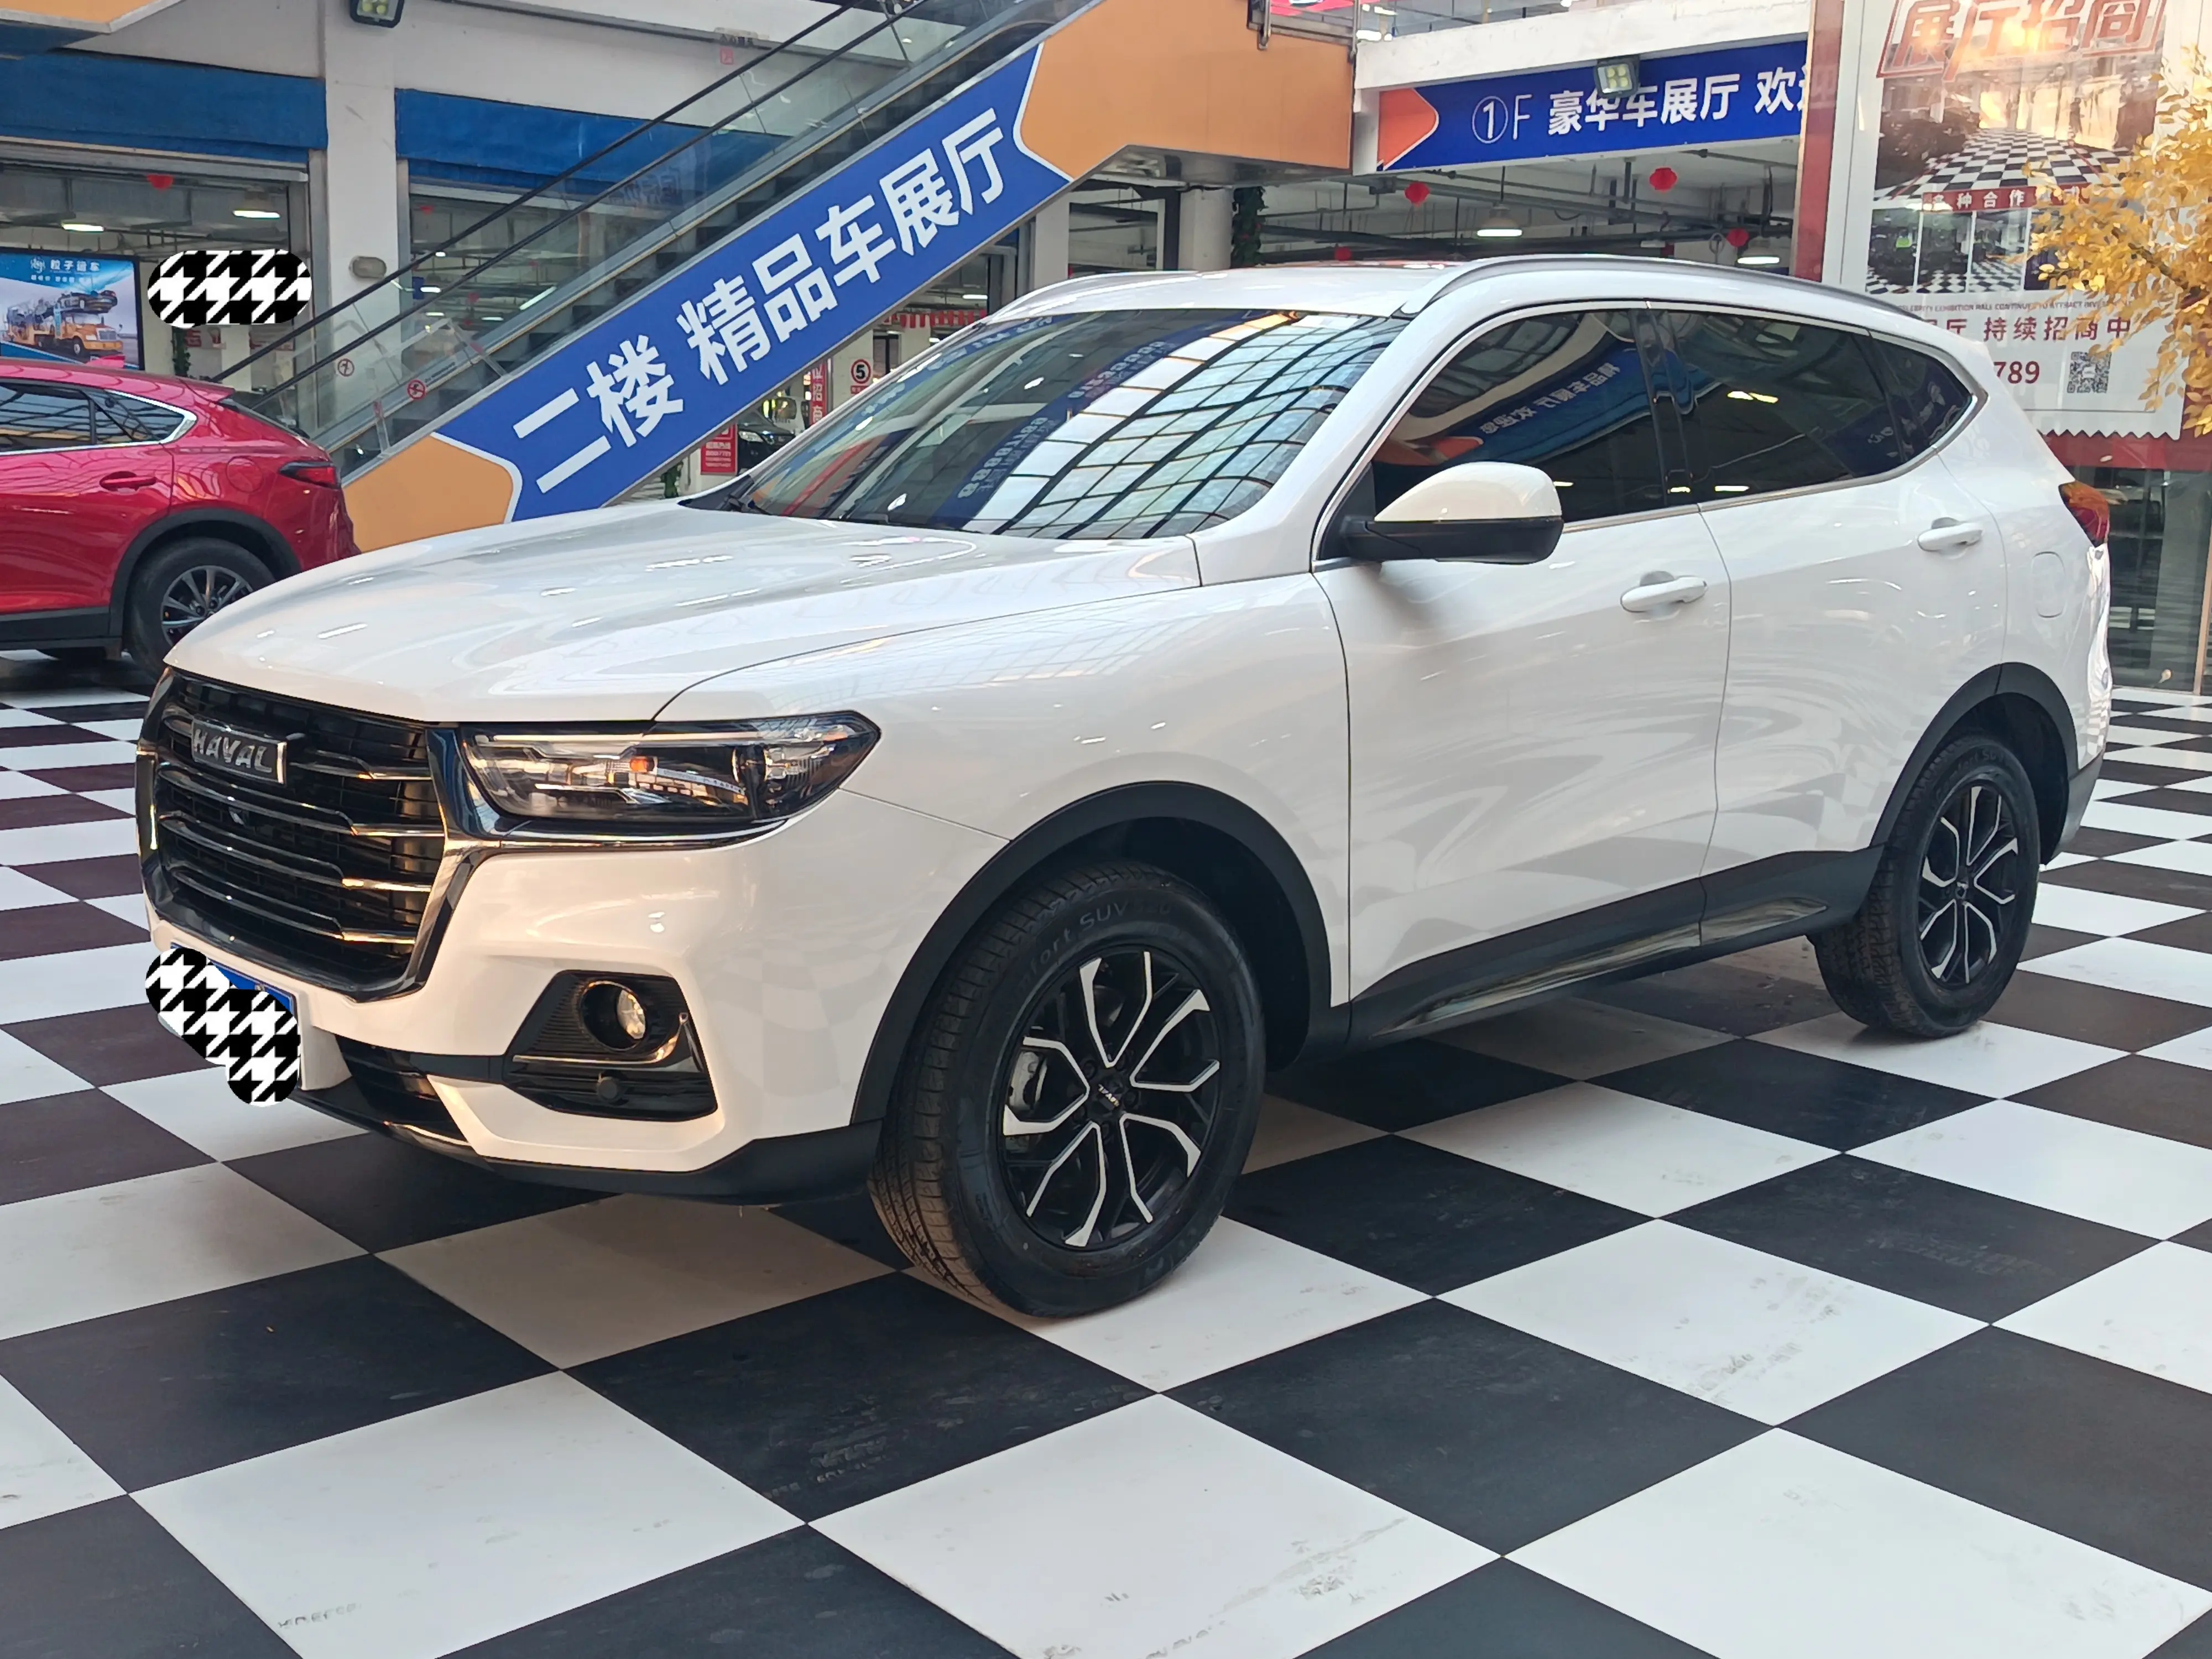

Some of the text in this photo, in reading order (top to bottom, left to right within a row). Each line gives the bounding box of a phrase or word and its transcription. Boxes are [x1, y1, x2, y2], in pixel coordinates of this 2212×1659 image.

[1548, 73, 1740, 136] 豪华车展厅
[513, 333, 685, 494] 二楼
[676, 107, 1004, 386] 精品车展厅
[1923, 315, 2131, 342] 厅 持续招商中
[855, 364, 865, 379] 5
[1994, 361, 2041, 384] 789
[194, 728, 273, 773] HAVAL
[1079, 900, 1129, 932] SUV
